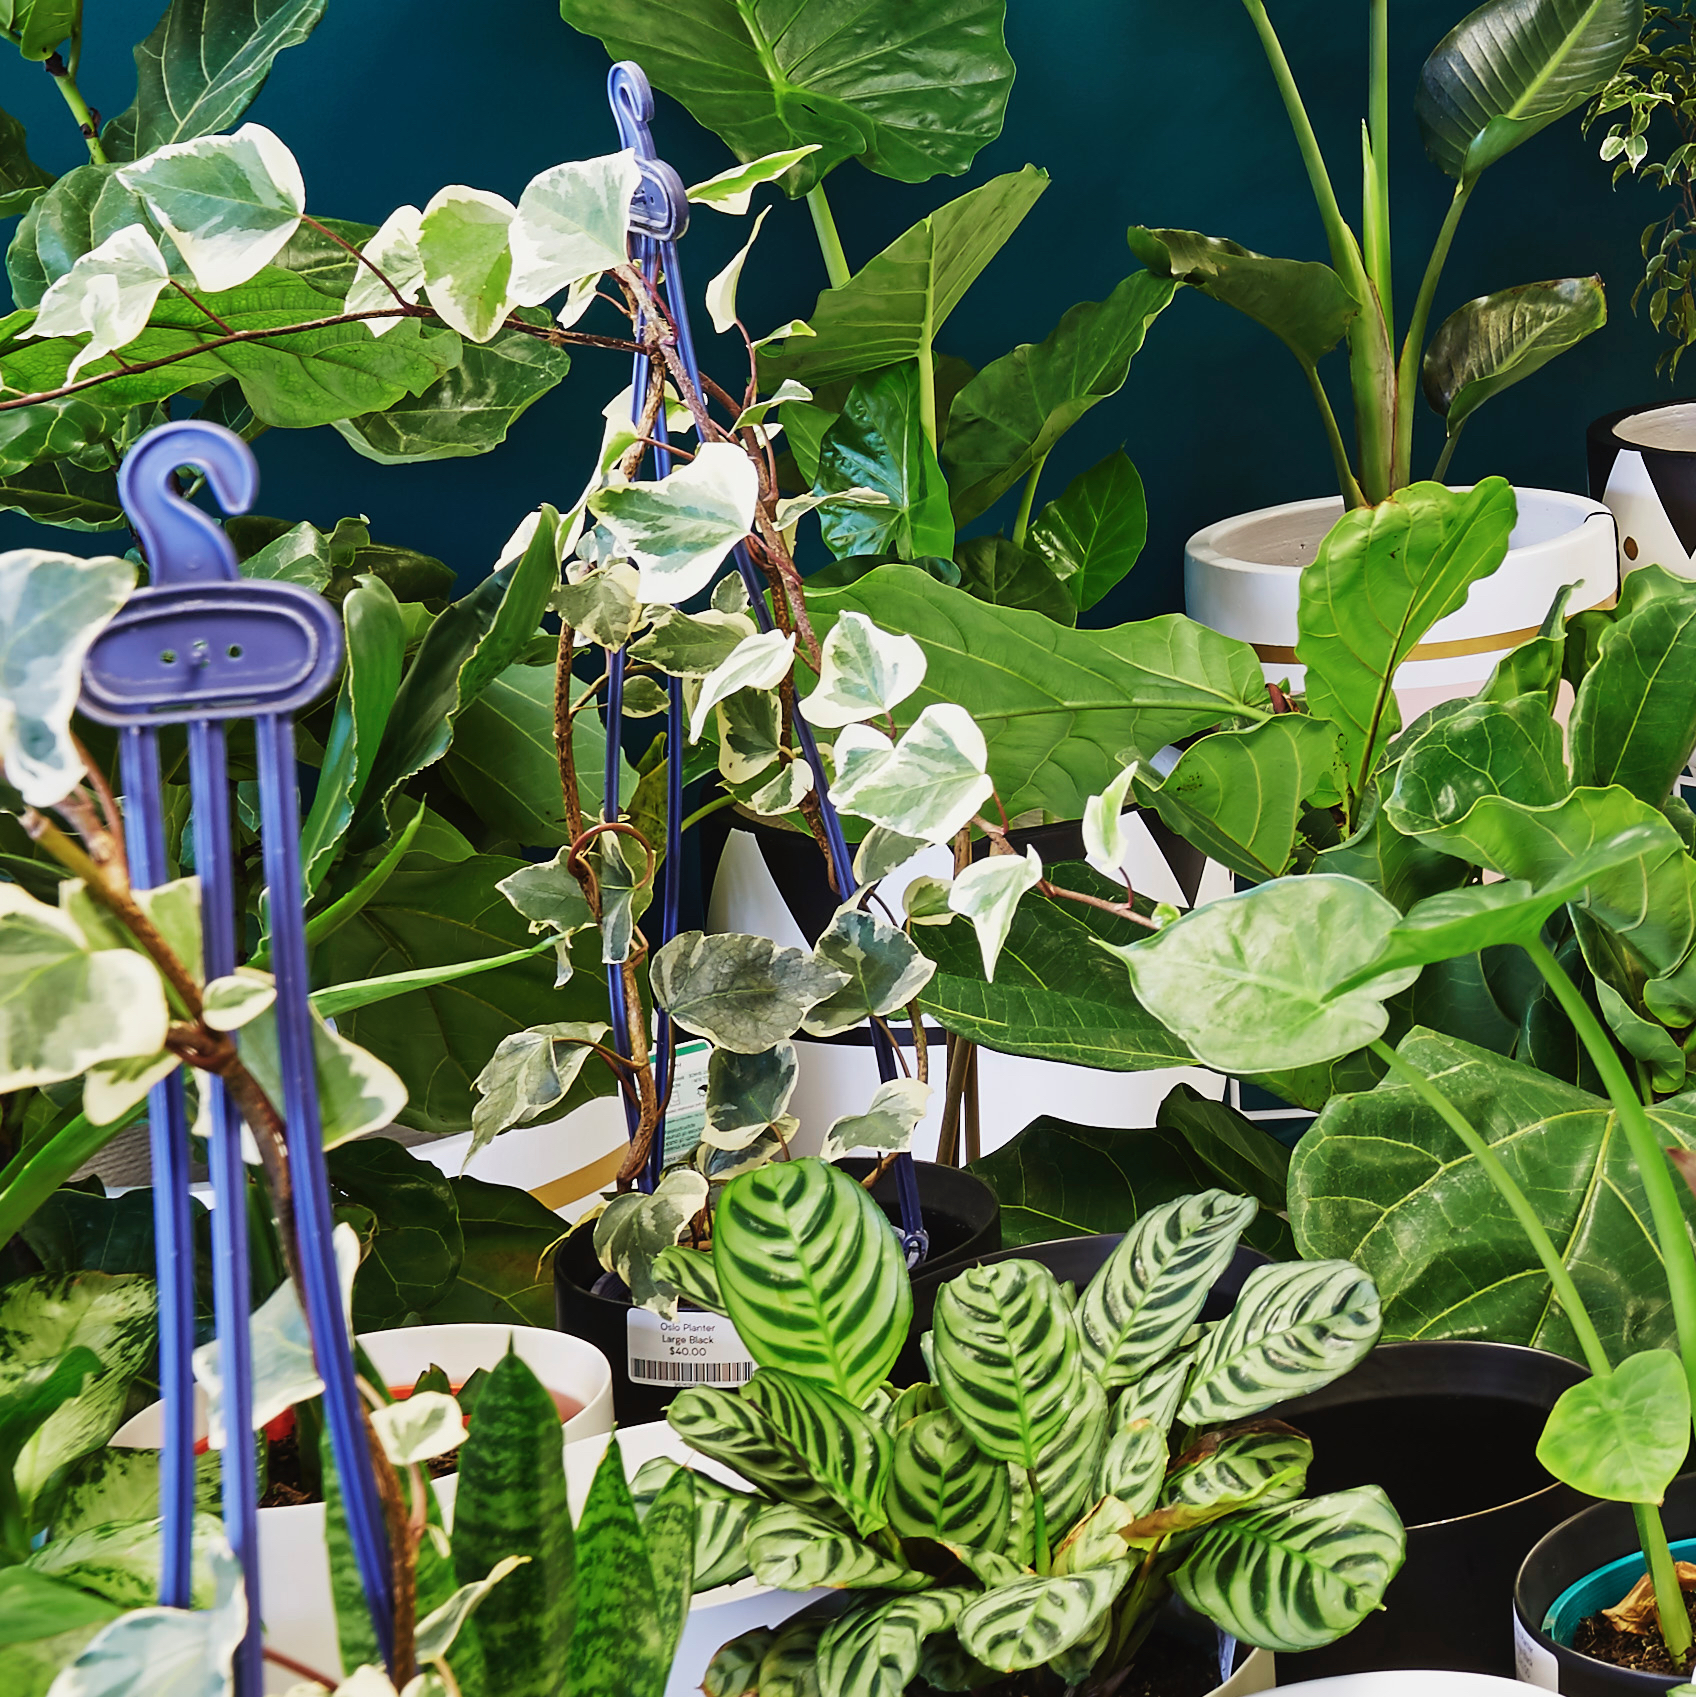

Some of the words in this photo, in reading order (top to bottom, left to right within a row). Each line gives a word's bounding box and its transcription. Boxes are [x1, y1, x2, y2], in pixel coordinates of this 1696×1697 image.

[660, 1322, 681, 1332] Oslo
[683, 1323, 716, 1332] Planter
[661, 1334, 687, 1346] Large
[689, 1335, 714, 1344] Black
[669, 1346, 707, 1356] $40.00
